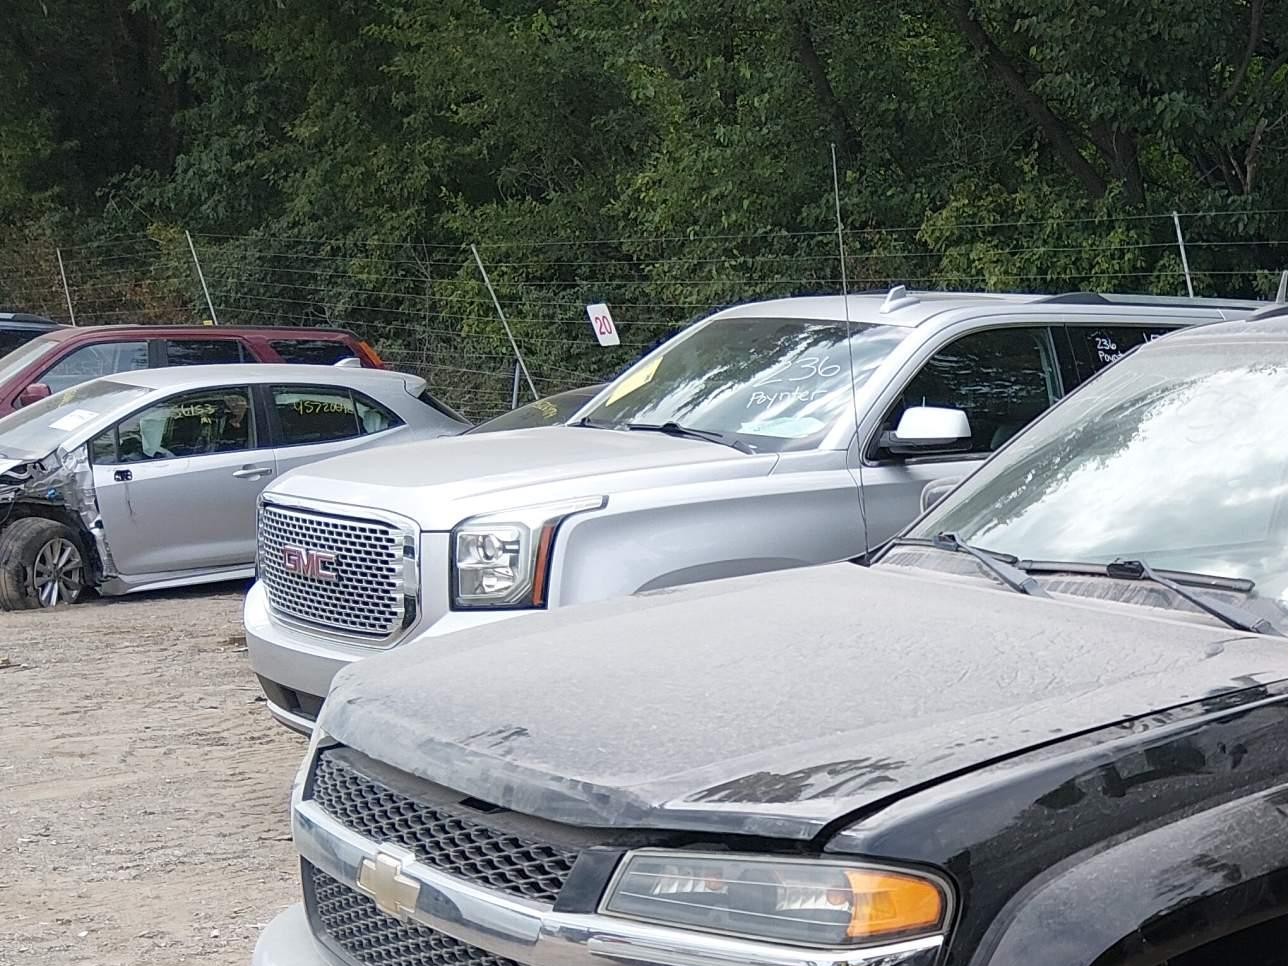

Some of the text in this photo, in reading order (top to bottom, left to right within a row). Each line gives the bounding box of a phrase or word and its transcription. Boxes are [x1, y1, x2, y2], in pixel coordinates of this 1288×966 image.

[595, 315, 613, 336] 20
[752, 356, 841, 387] 236
[746, 386, 828, 409] Poynter
[283, 545, 337, 581] GMC
